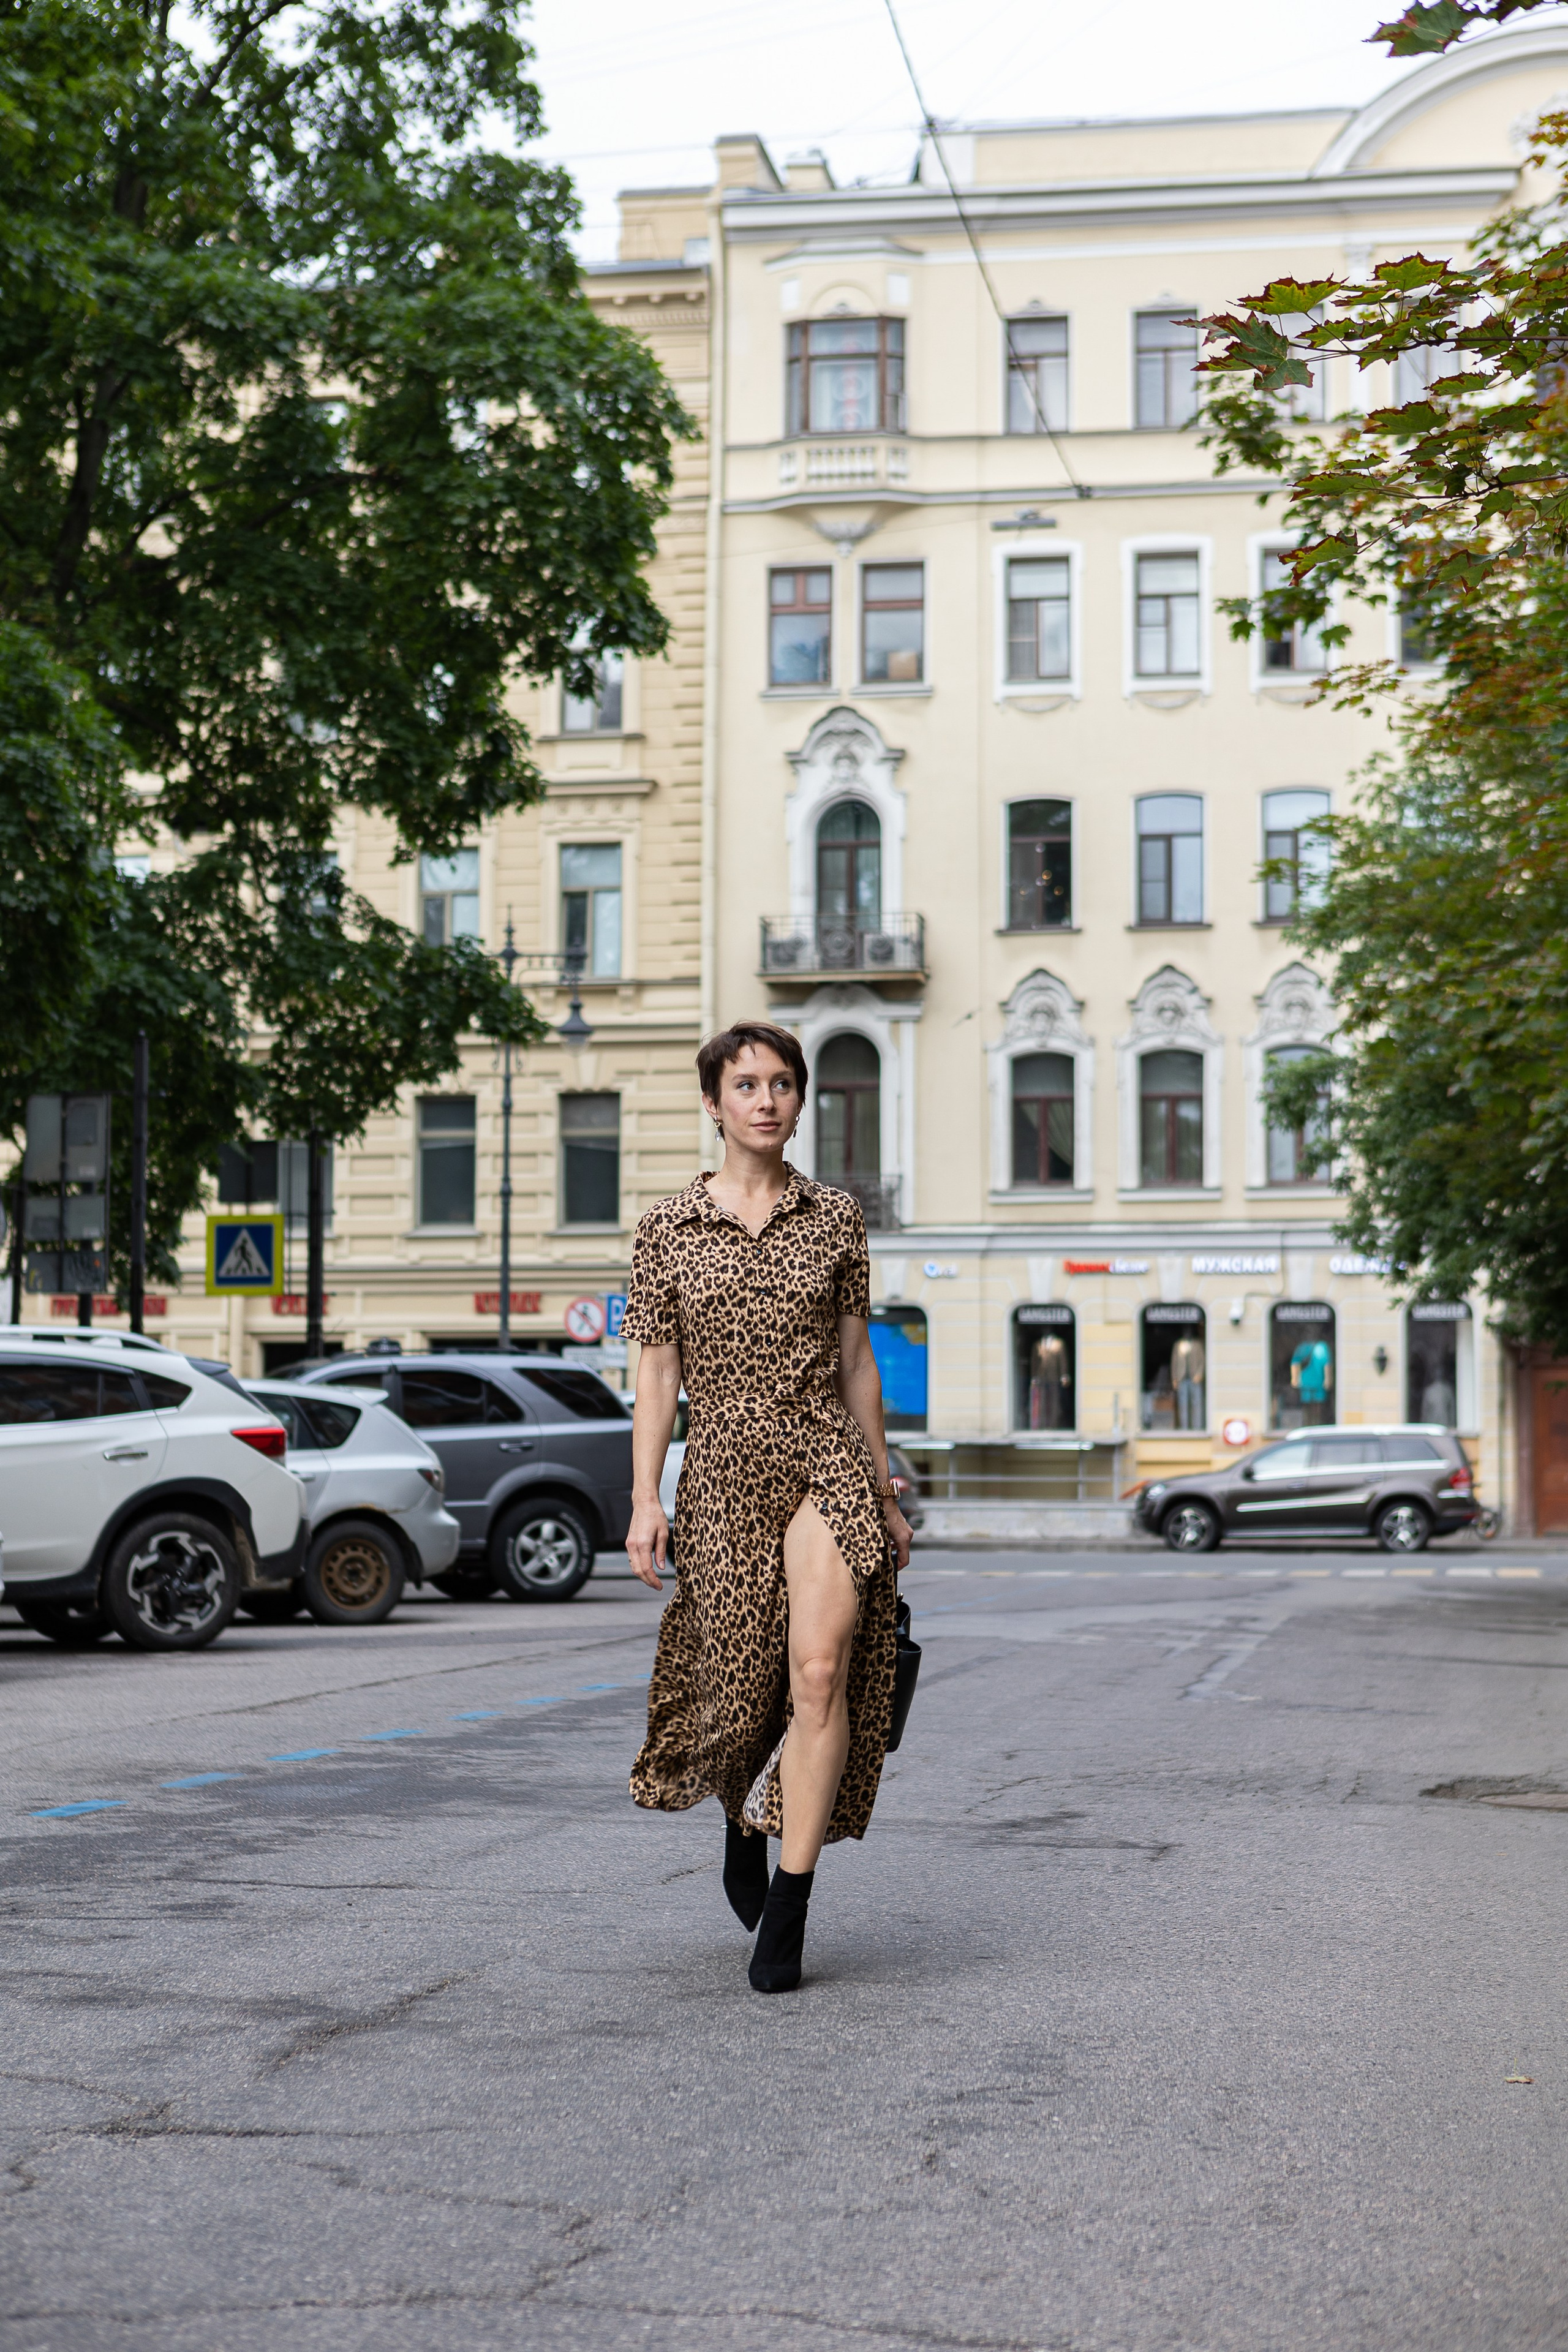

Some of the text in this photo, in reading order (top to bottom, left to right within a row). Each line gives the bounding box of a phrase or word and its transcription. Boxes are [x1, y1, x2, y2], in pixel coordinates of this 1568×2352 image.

[1191, 1254, 1407, 1274] МУЖСКАЯ ОДЕЖ
[611, 1299, 624, 1332] P
